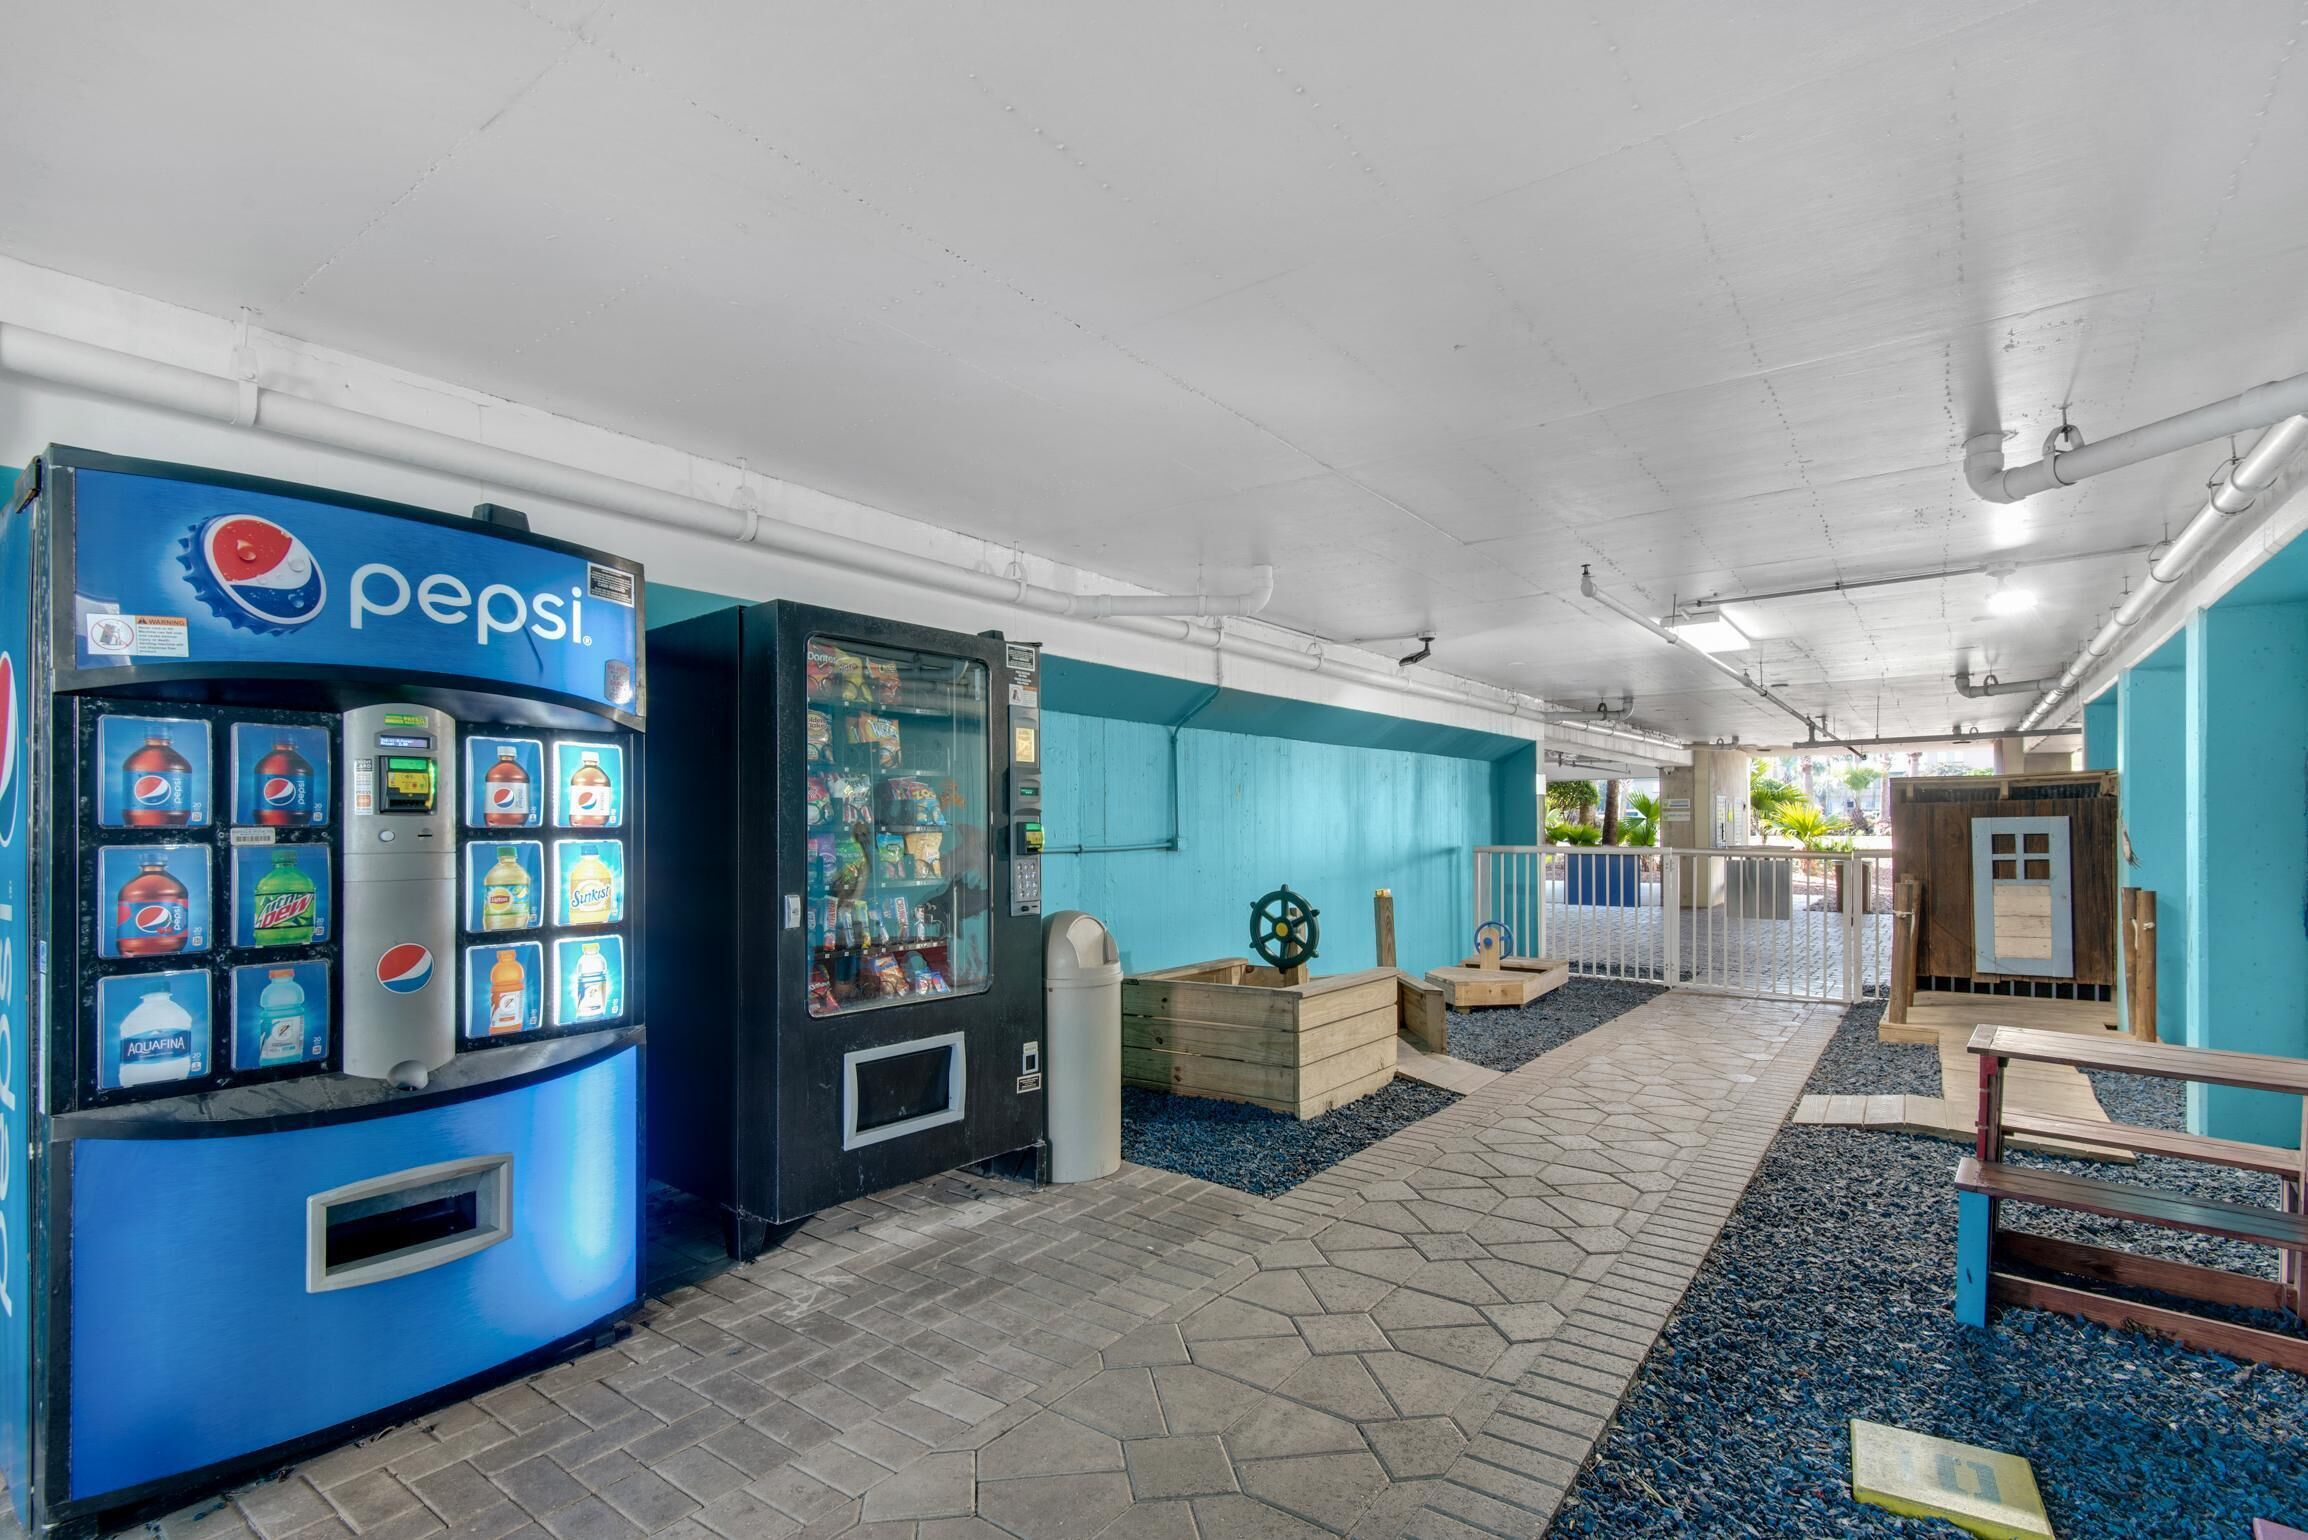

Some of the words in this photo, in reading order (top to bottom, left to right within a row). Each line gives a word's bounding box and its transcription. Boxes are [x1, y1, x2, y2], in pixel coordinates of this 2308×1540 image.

[350, 563, 583, 645] pepsi
[149, 619, 185, 627] WARNING
[296, 780, 306, 805] pepsi
[127, 1036, 186, 1057] AQUAFINA
